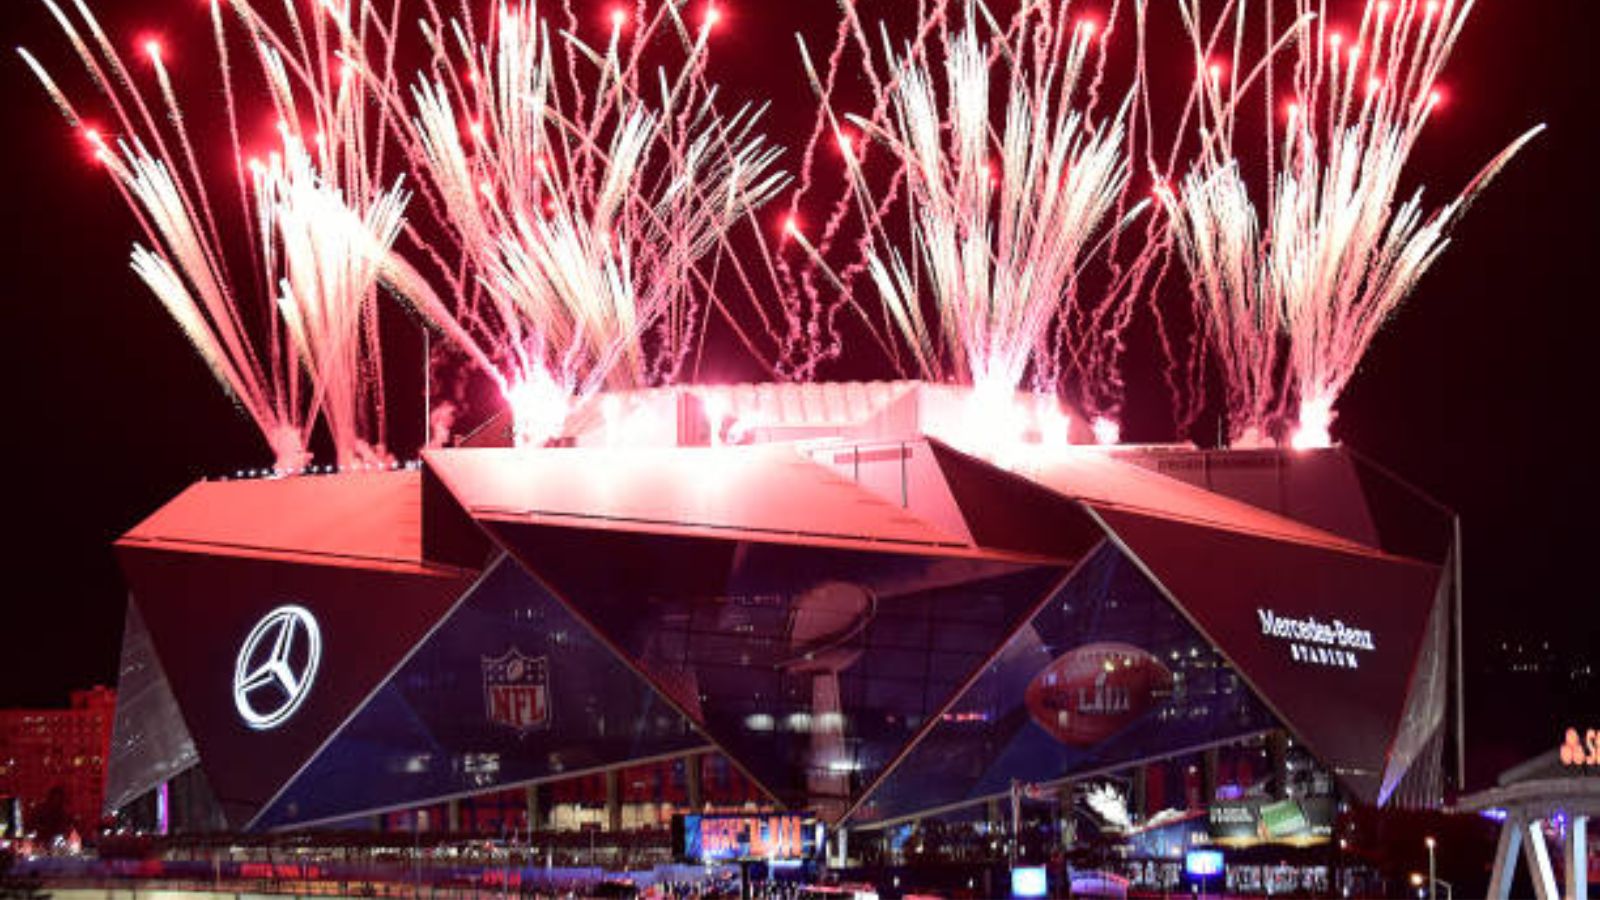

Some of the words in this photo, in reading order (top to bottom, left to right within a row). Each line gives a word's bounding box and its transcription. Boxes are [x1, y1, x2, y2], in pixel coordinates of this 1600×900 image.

[1257, 608, 1376, 650] Mercedes-Benz
[1290, 643, 1358, 669] STADIUM
[493, 686, 545, 725] NFL
